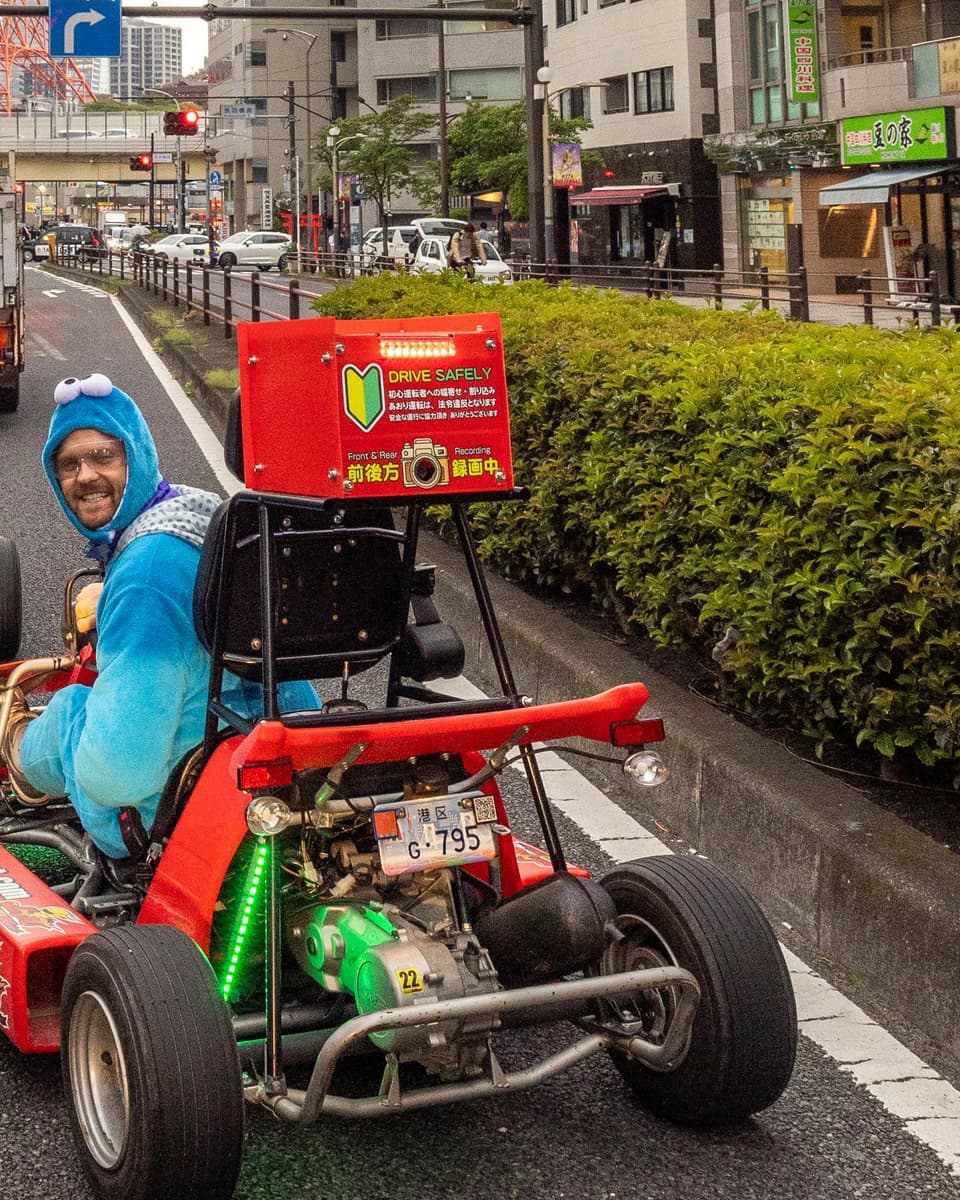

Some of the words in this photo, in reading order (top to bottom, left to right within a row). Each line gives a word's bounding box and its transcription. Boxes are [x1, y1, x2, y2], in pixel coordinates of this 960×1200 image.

[873, 116, 913, 150] 豆の家
[389, 370, 432, 383] DRIVE
[436, 368, 492, 381] SAFELY
[348, 452, 369, 460] Front
[371, 452, 377, 460] &
[380, 451, 398, 459] Rear
[455, 447, 491, 456] Recording
[347, 463, 400, 483] 前後方
[452, 458, 499, 478] 録画中
[418, 806, 448, 823] 港区
[408, 842, 421, 860] G
[399, 970, 420, 989] 22
